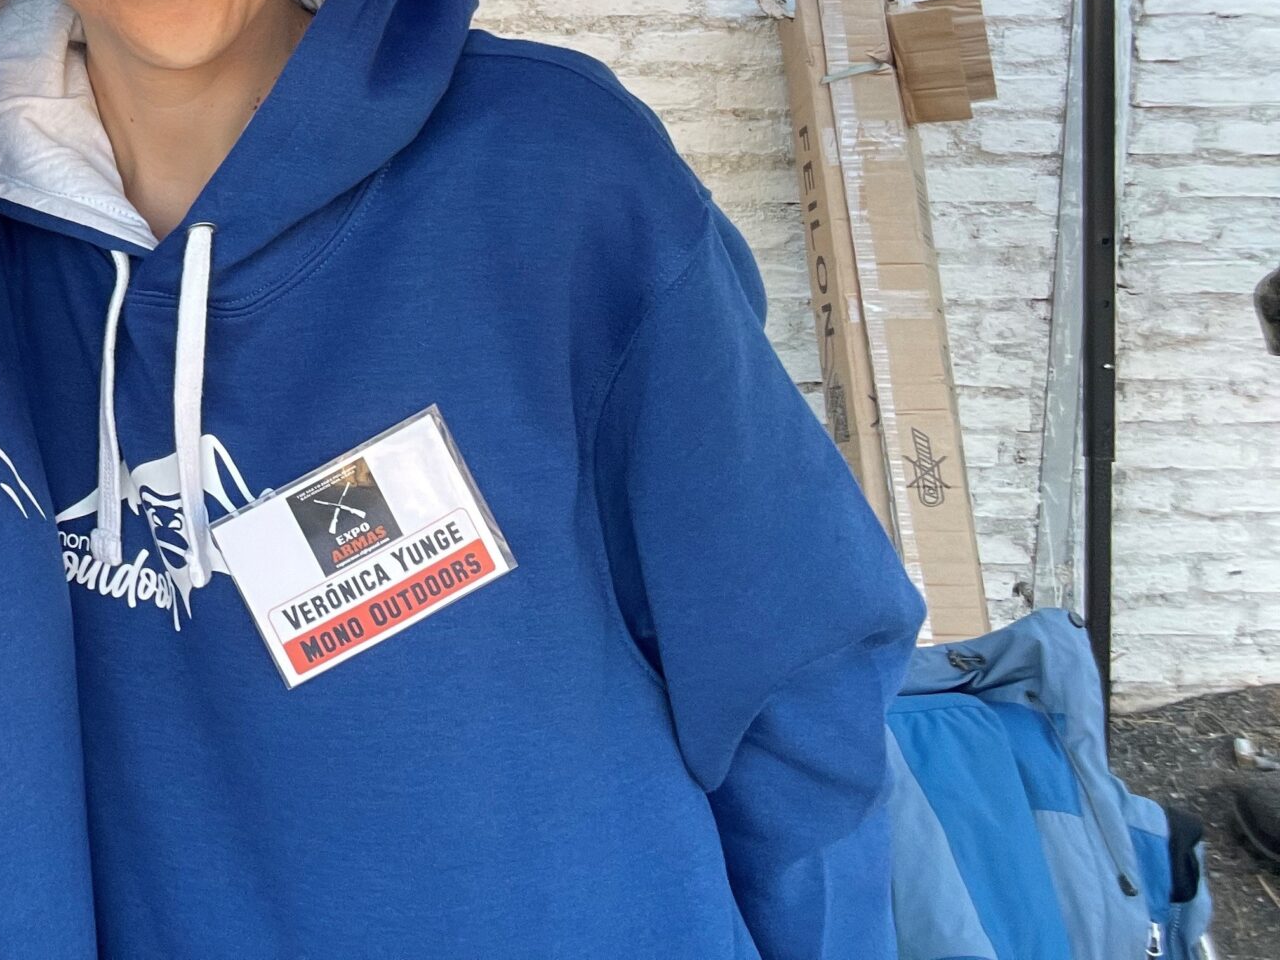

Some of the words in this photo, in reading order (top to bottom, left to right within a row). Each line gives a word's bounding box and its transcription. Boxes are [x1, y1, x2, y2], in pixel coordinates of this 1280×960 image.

[331, 525, 387, 563] ARMAS
[335, 521, 370, 546] EXPO
[281, 562, 392, 631] VERÓNICA
[390, 520, 464, 572] YUNGE
[299, 615, 365, 663] MONO
[369, 552, 482, 627] OUTDOORS
